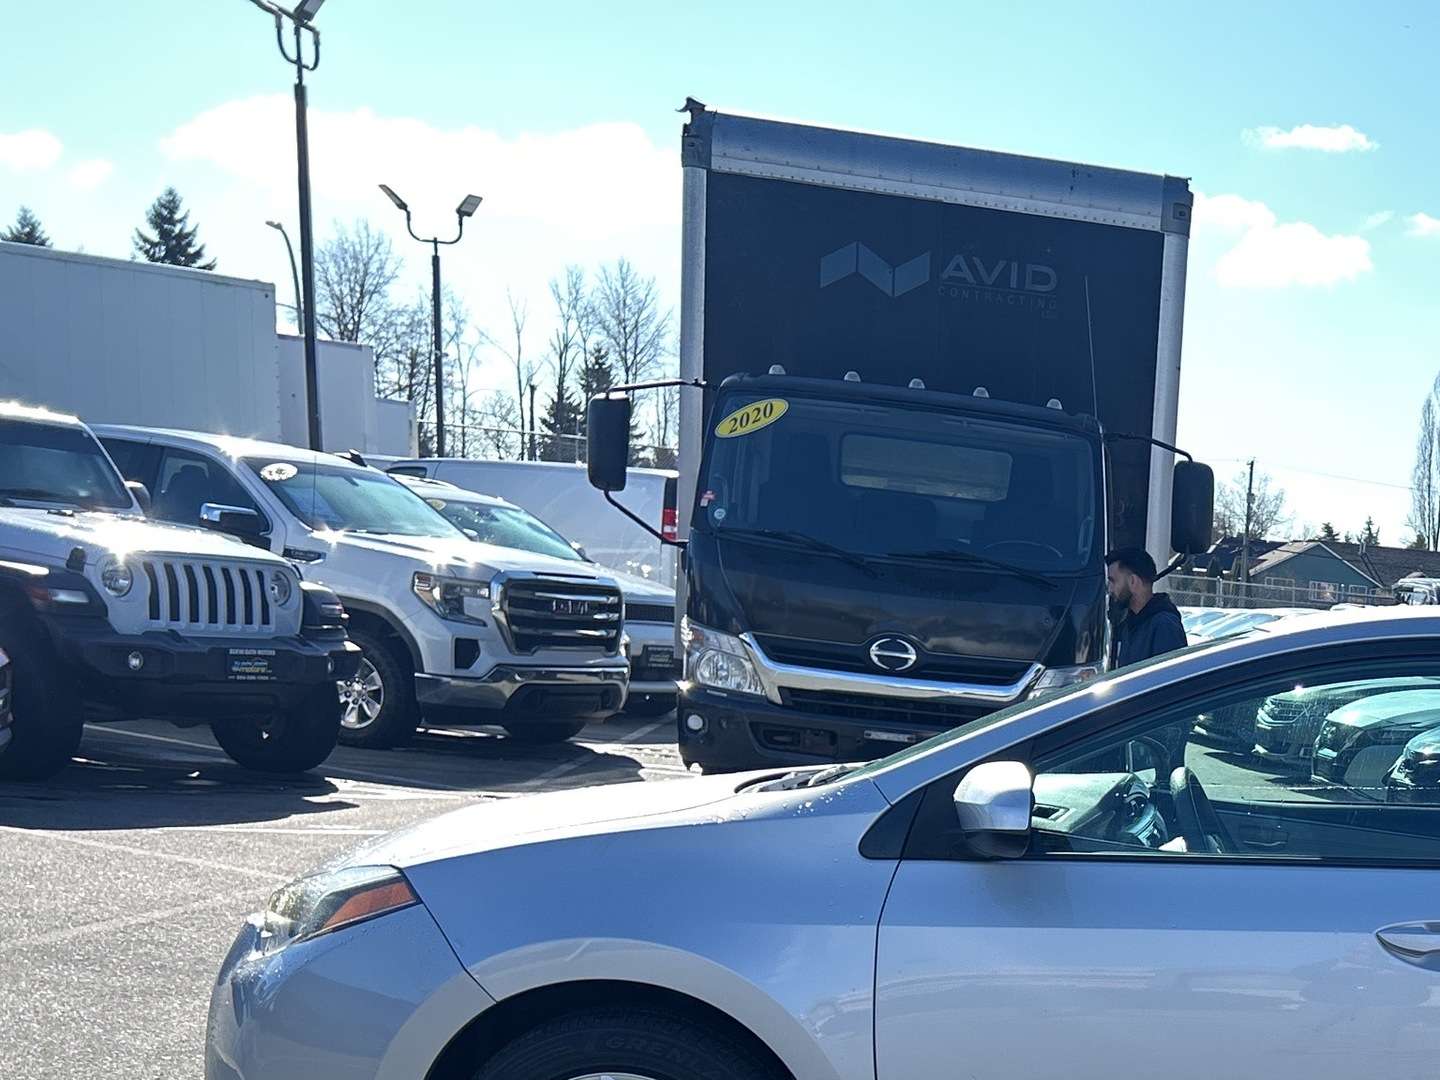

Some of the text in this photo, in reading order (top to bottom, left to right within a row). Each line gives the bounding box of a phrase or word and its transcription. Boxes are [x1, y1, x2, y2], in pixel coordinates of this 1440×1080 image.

[941, 253, 1058, 293] AVID
[937, 285, 1057, 310] CONTRACTING
[727, 401, 774, 435] 2020
